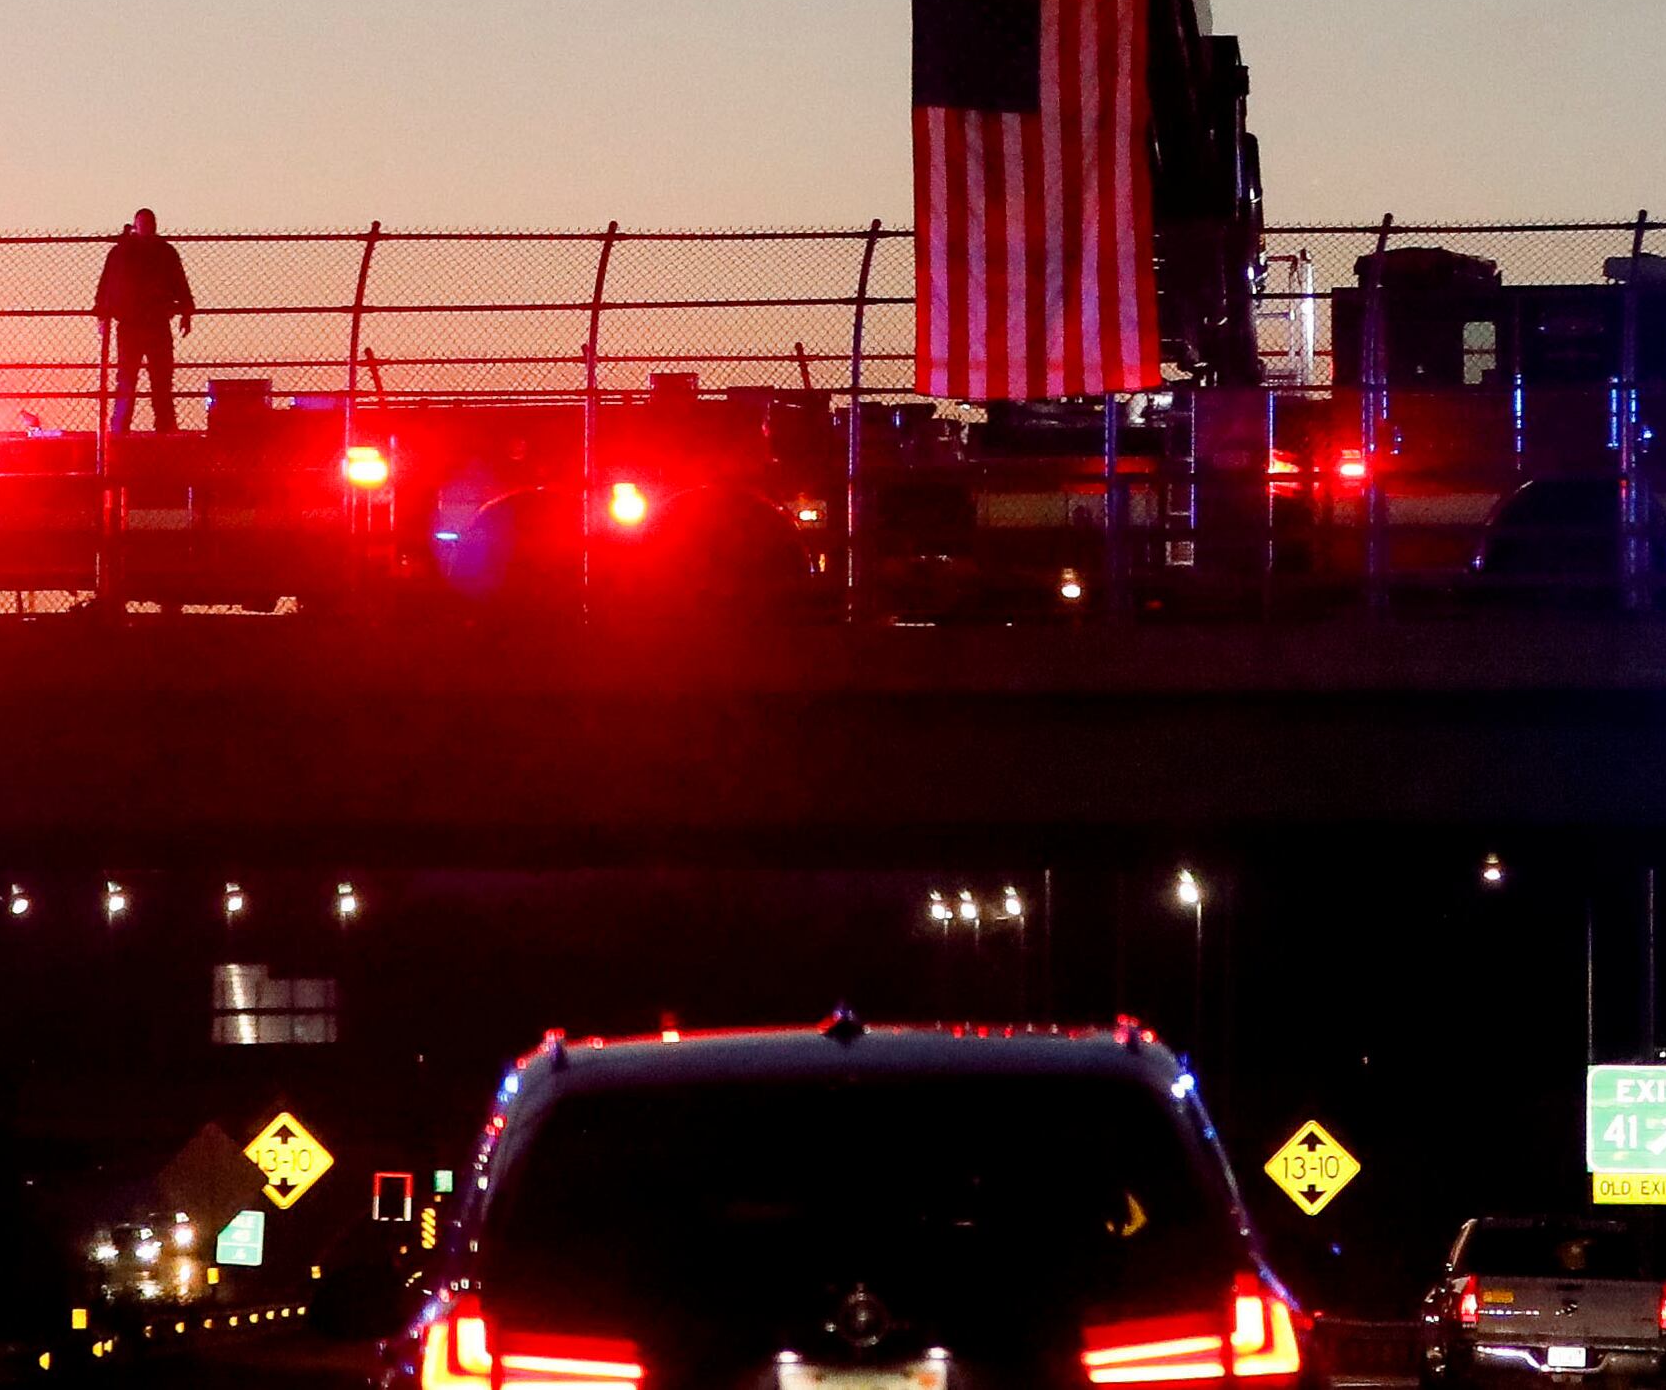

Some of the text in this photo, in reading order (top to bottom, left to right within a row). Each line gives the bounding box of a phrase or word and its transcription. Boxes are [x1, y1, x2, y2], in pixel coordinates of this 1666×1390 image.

[1603, 1114, 1638, 1150] 41
[1283, 1155, 1339, 1179] 13-10
[1599, 1180, 1631, 1196] OLD
